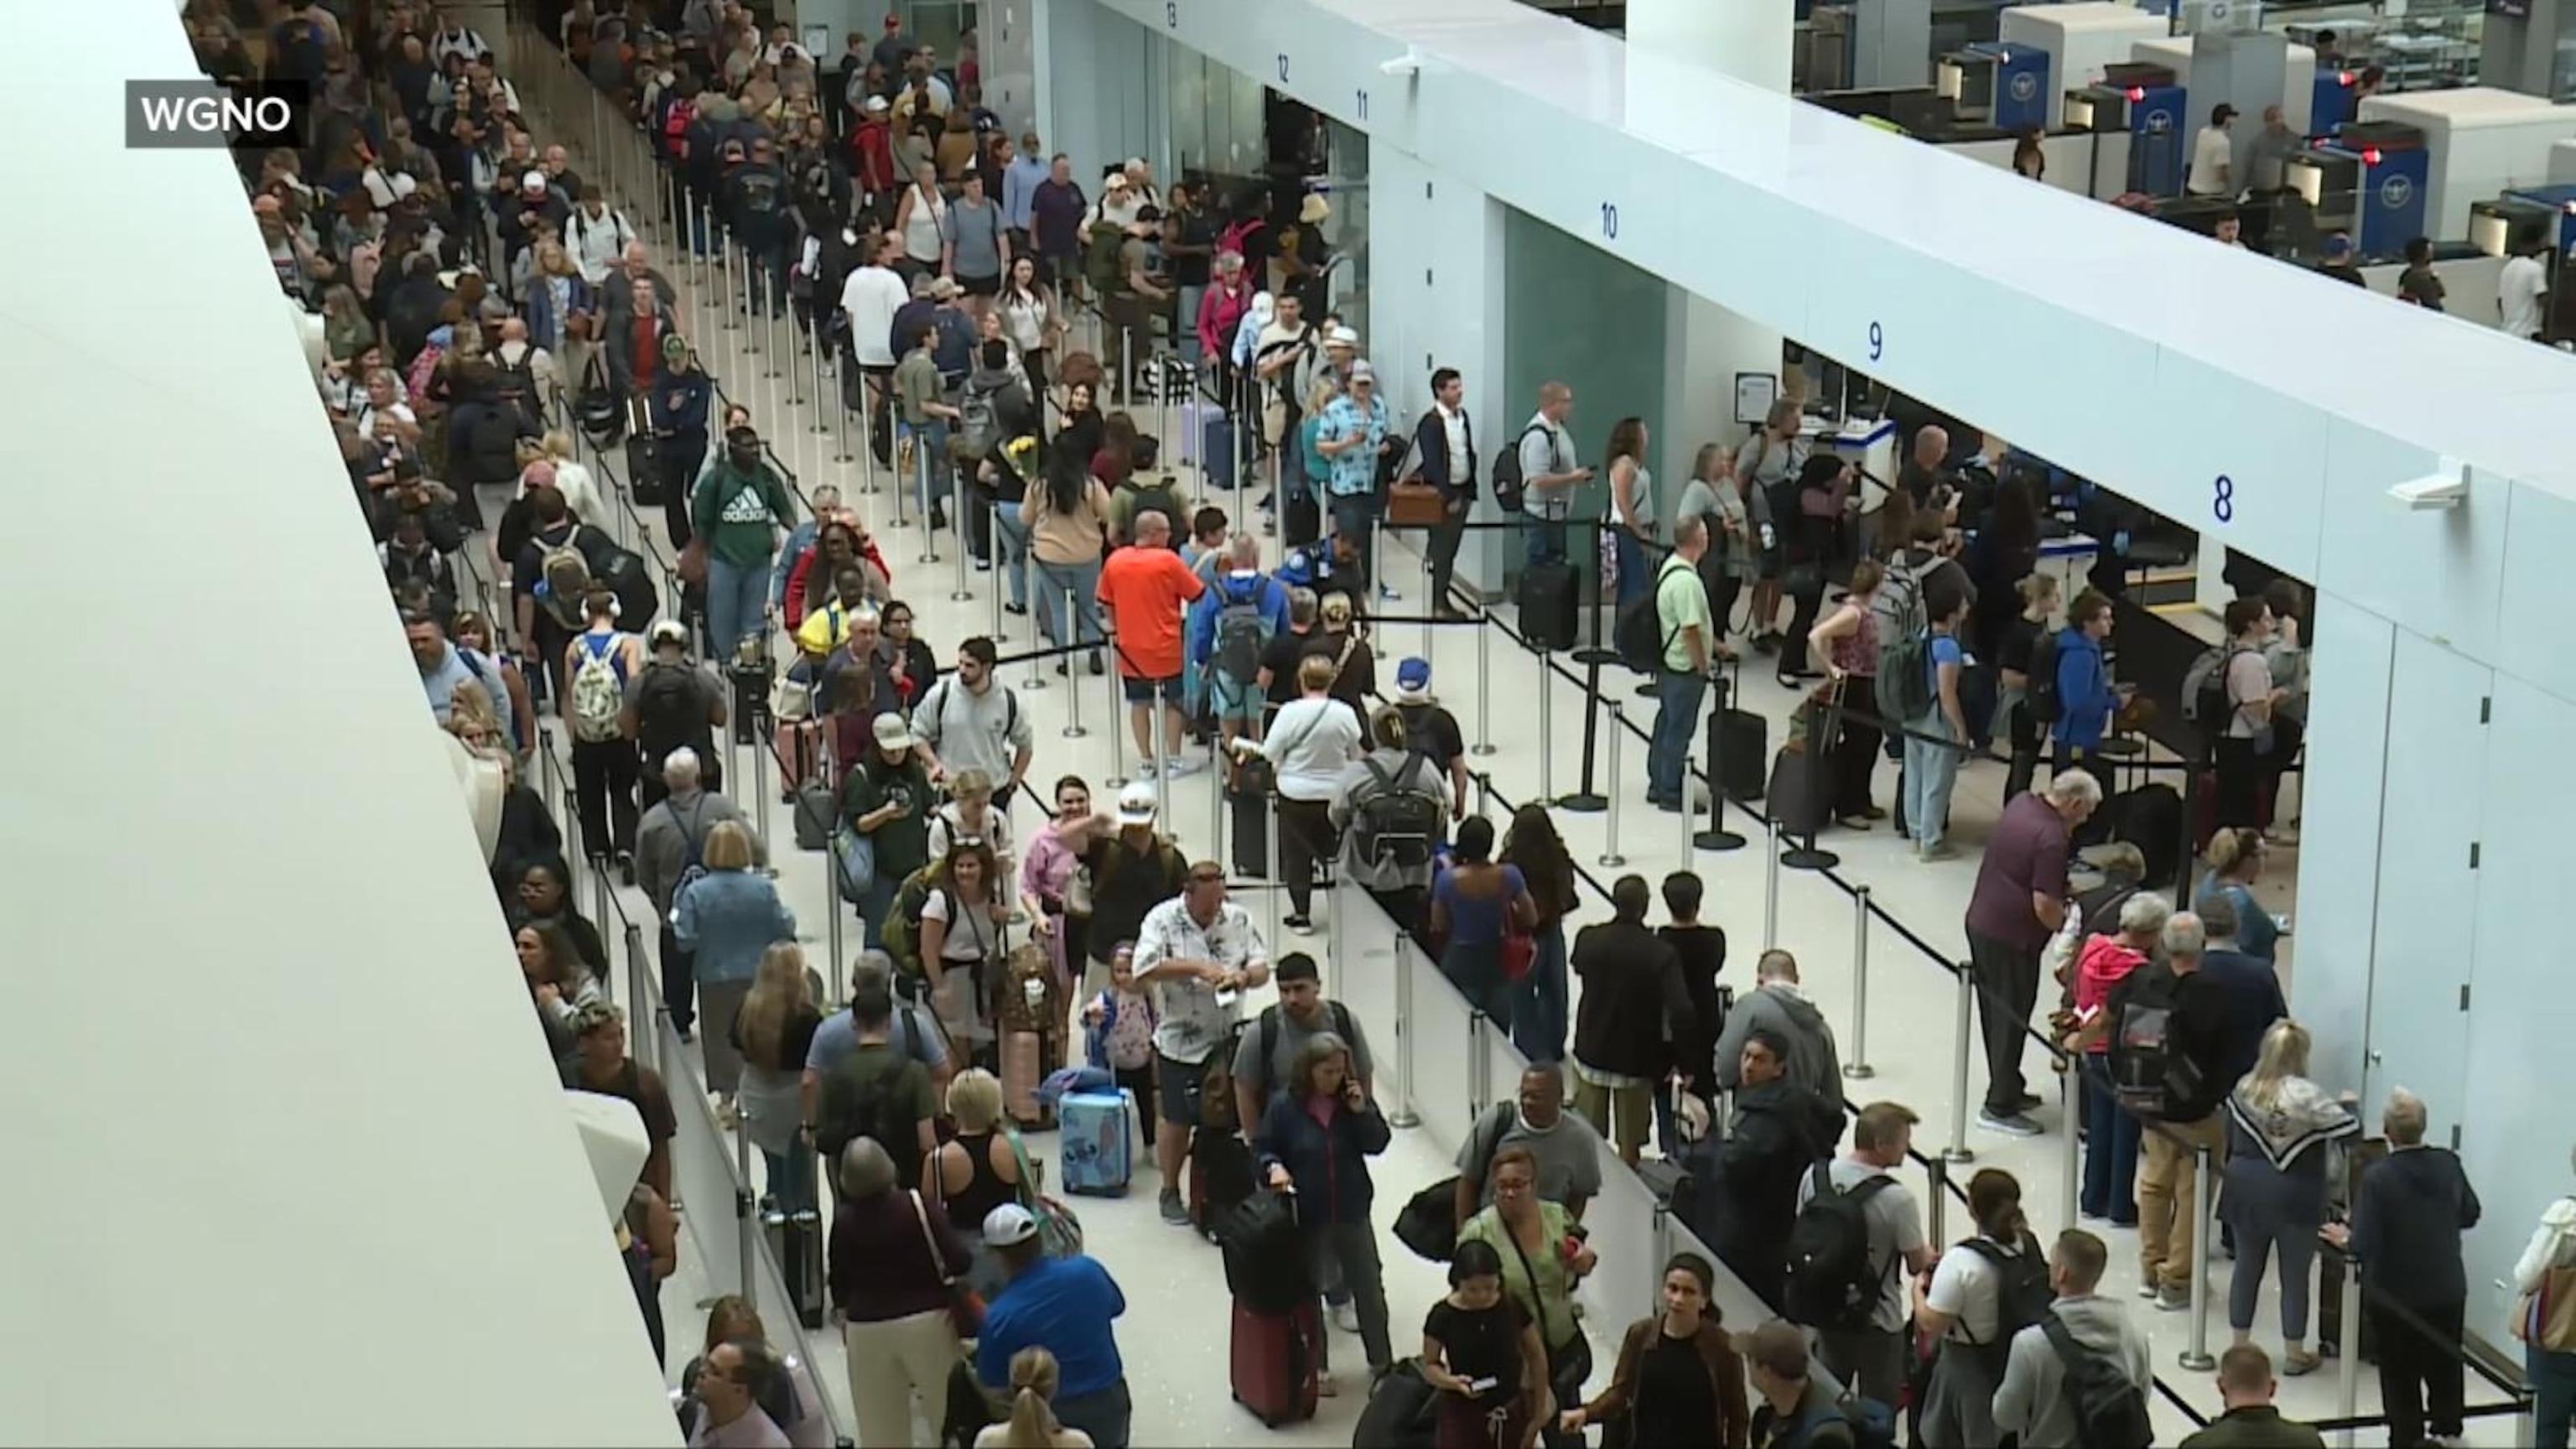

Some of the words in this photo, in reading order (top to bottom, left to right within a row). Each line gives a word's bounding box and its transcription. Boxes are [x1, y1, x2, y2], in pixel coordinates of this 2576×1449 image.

[1166, 2, 1176, 29] 13
[1277, 53, 1289, 83] 12
[1356, 89, 1368, 121] 11
[1601, 200, 1618, 241] 10
[1868, 321, 1883, 361] 9
[2213, 474, 2234, 524] 8
